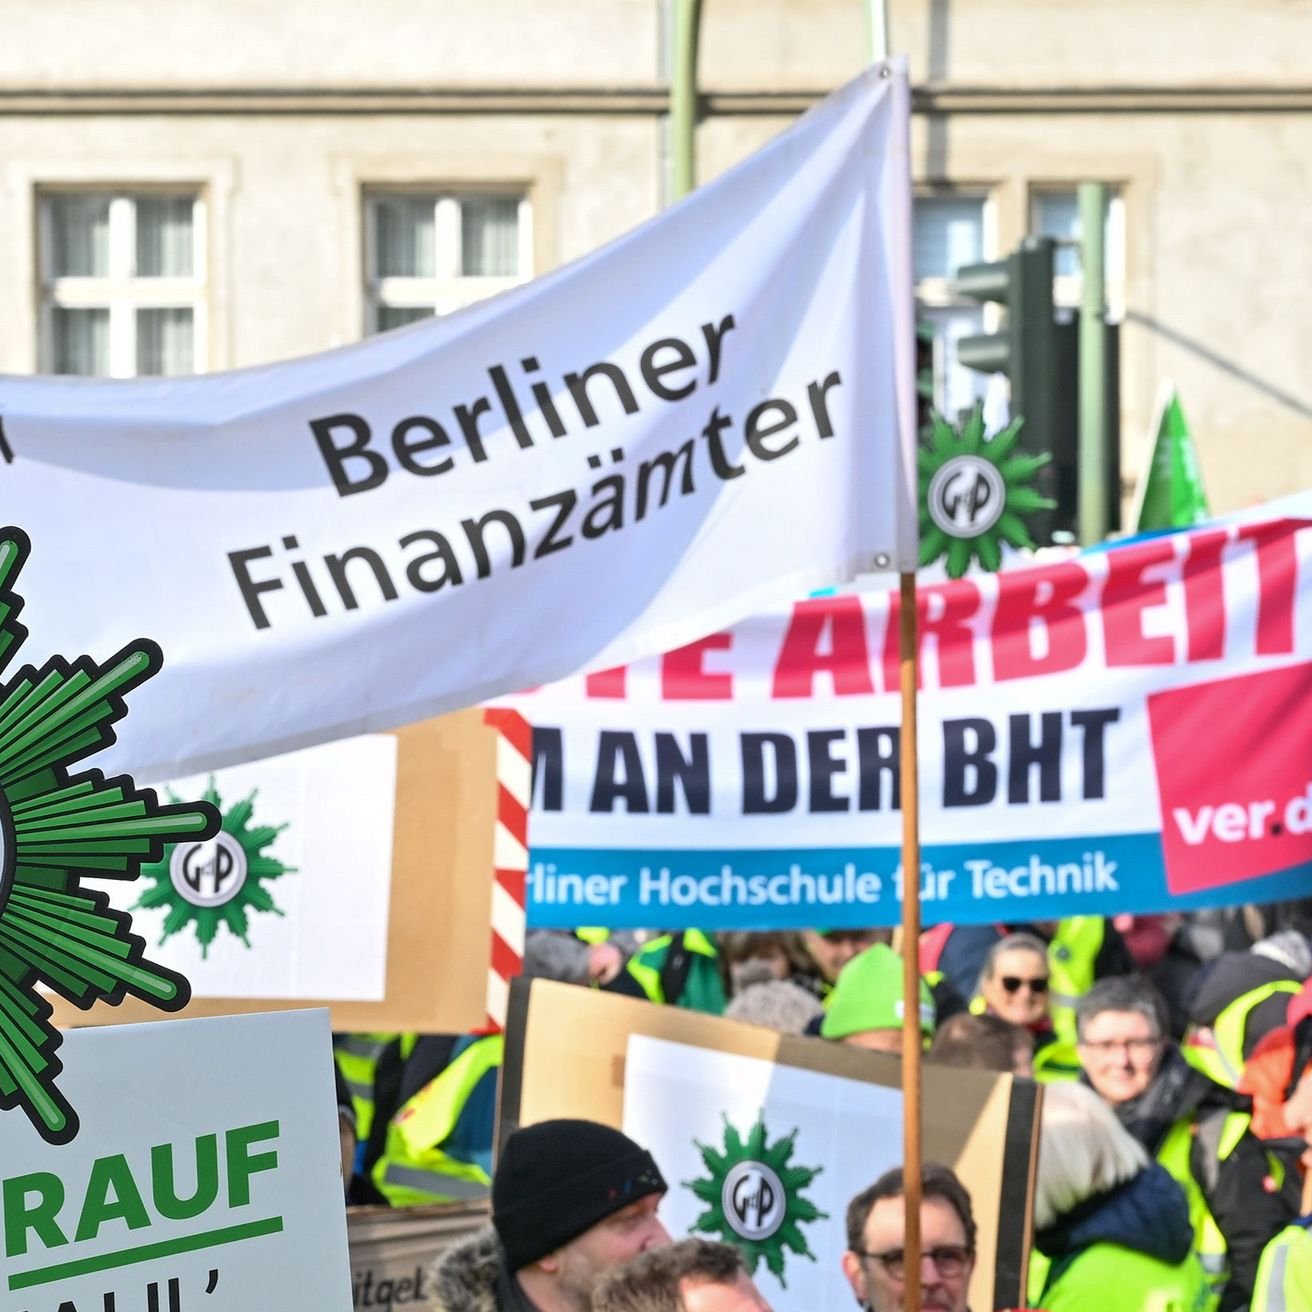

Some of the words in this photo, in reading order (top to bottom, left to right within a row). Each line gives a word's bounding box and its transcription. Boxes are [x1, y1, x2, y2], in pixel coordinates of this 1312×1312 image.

[308, 313, 736, 499] Berliner
[226, 370, 843, 631] Finanzämter
[589, 731, 711, 816] AN
[740, 726, 902, 816] DER
[942, 707, 1121, 809] BHT
[639, 862, 883, 906] Hochschule
[963, 850, 1120, 900] Technik
[3, 1120, 281, 1258] RAUF
